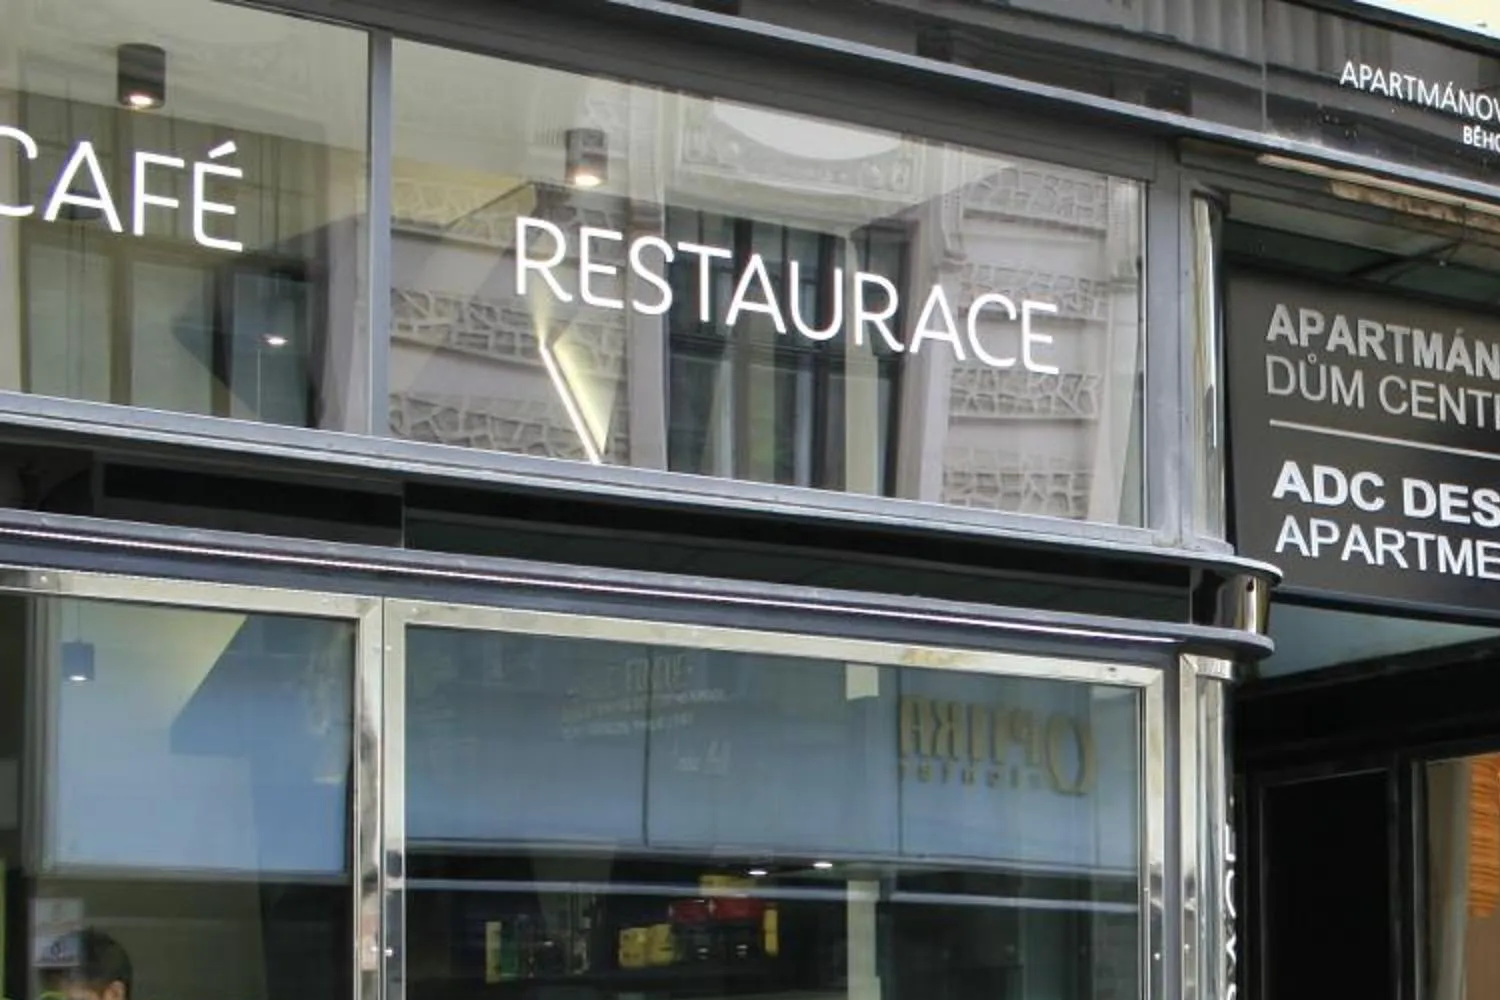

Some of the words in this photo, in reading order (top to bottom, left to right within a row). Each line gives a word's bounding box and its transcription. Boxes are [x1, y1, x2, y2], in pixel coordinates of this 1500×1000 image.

[514, 216, 1060, 375] RESTAURACE
[1265, 352, 1365, 409] DŮM
[1272, 460, 1386, 511] ADC
